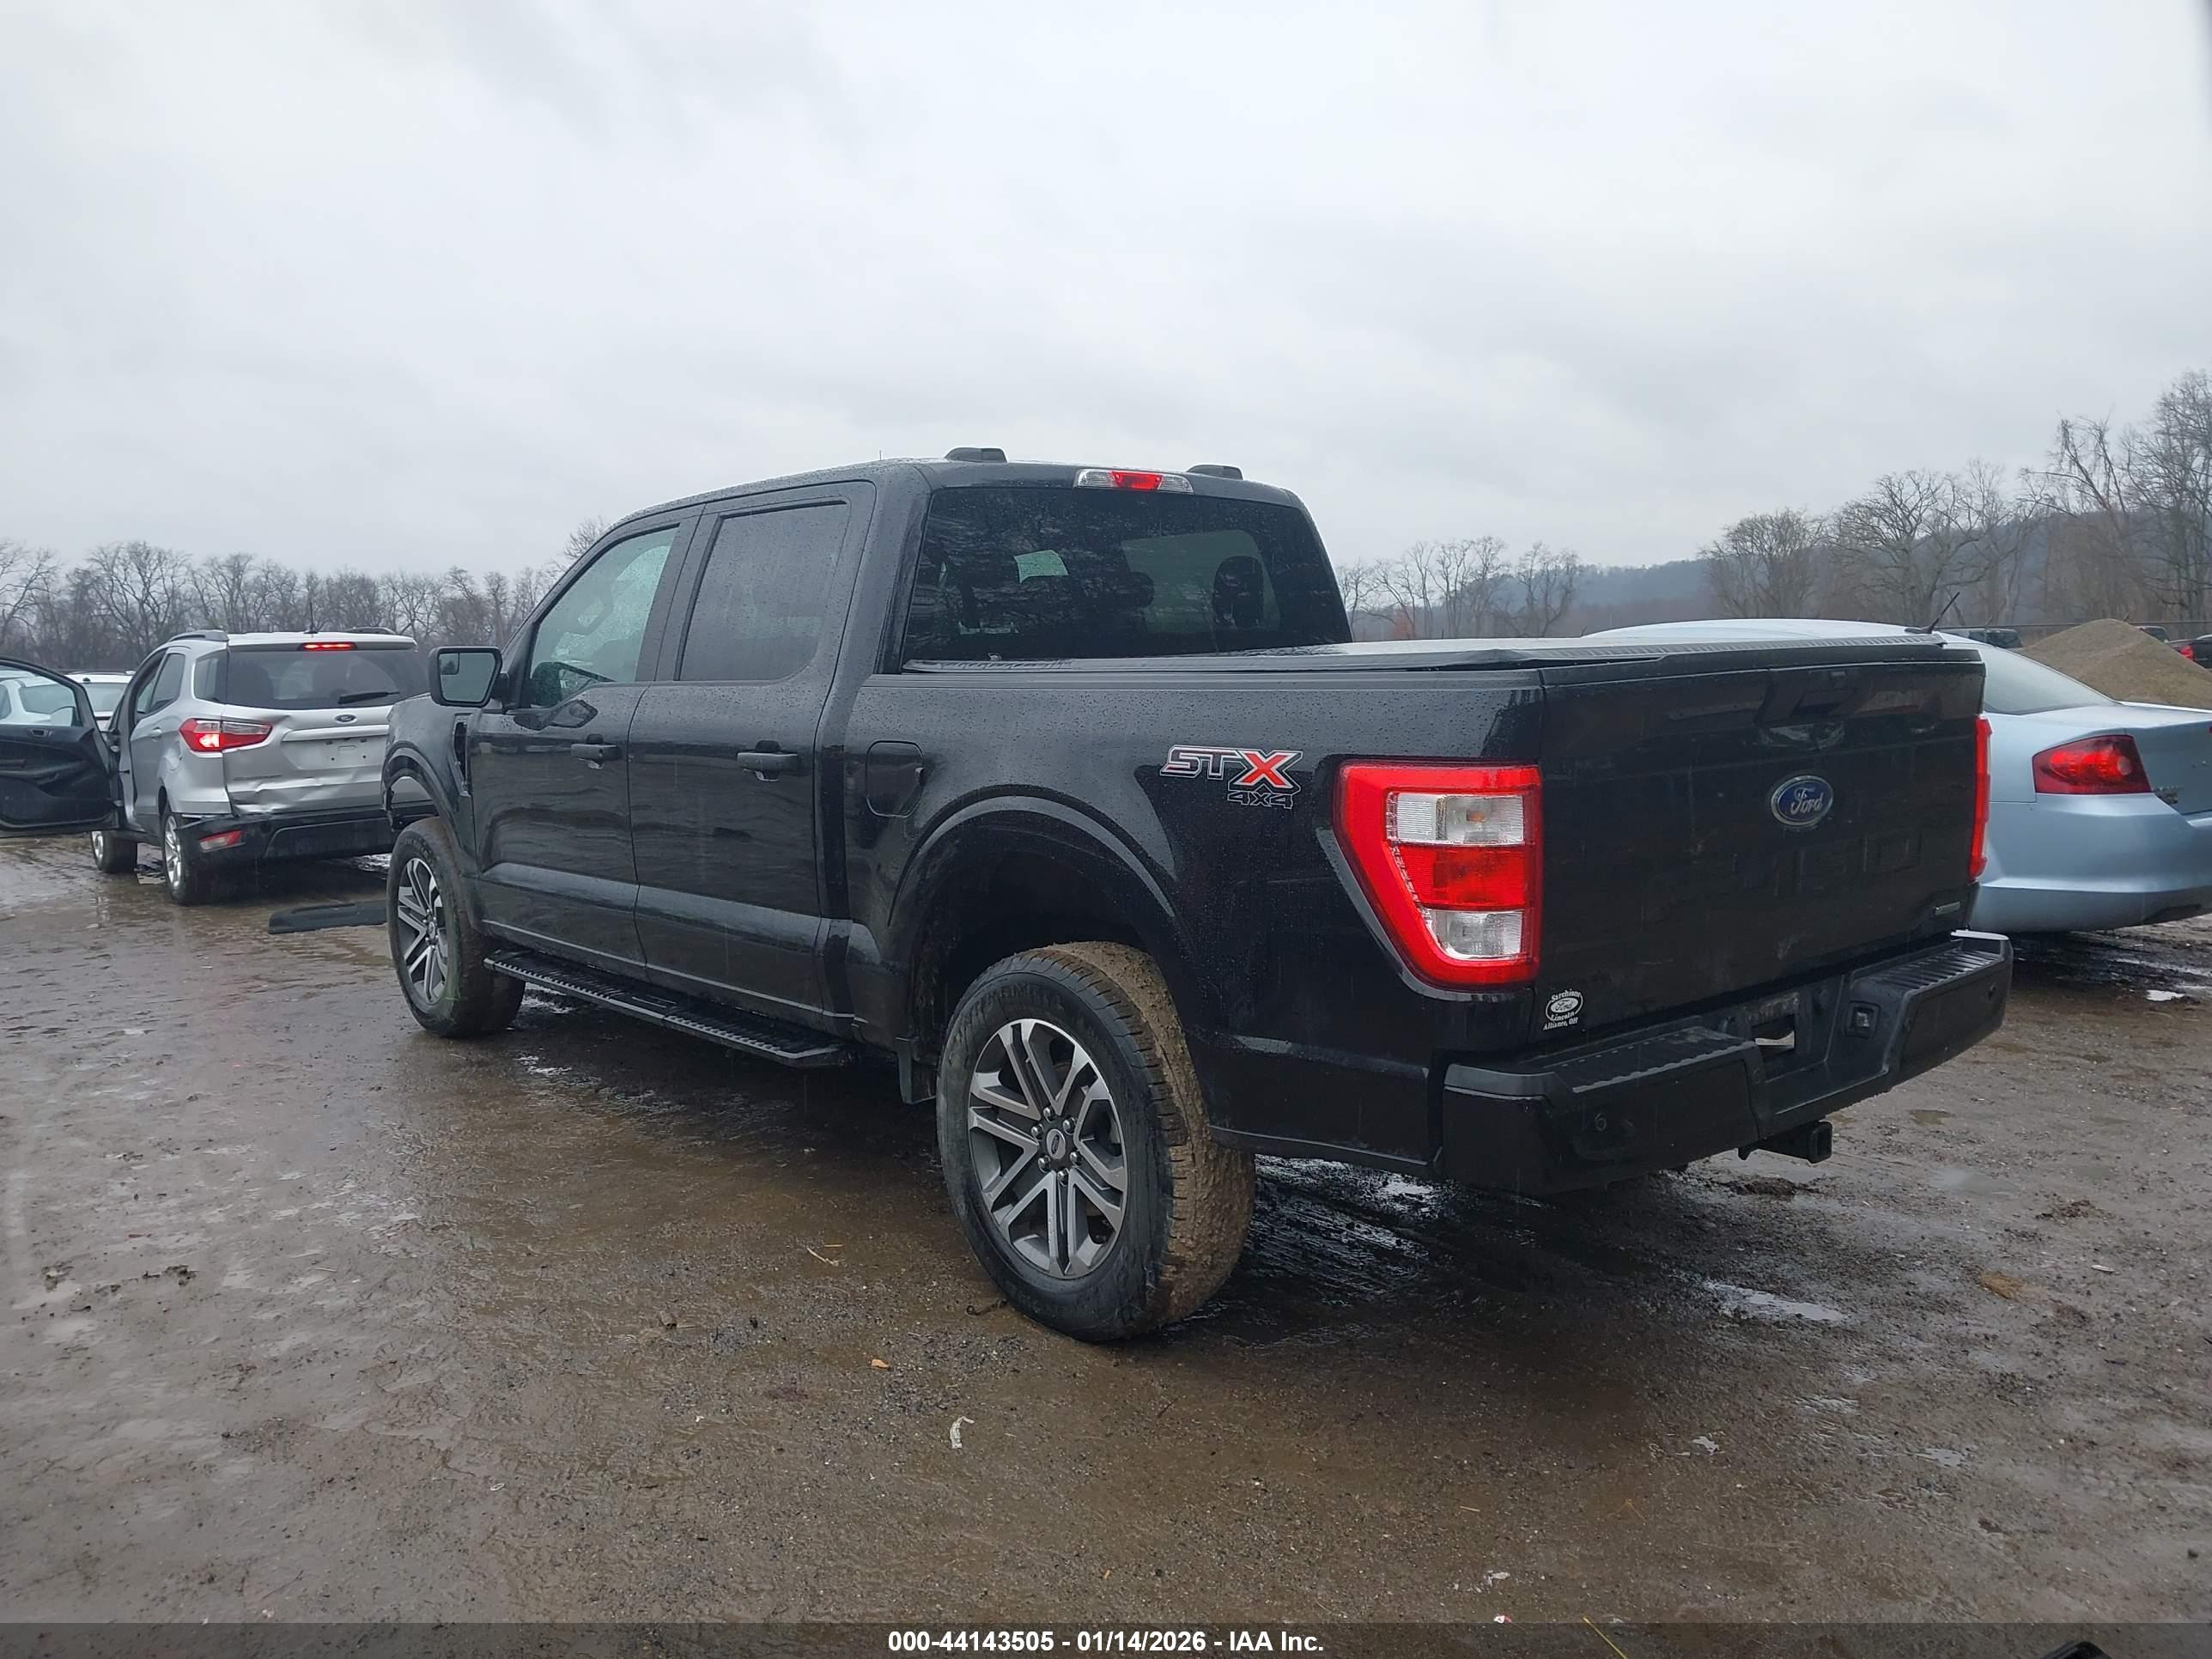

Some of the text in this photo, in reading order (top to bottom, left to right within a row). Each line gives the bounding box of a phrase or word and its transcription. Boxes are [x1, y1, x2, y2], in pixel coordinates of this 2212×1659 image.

[1160, 744, 1303, 793] STX
[1790, 787, 1824, 815] Ford
[1551, 1012, 1575, 1022] Lincoln
